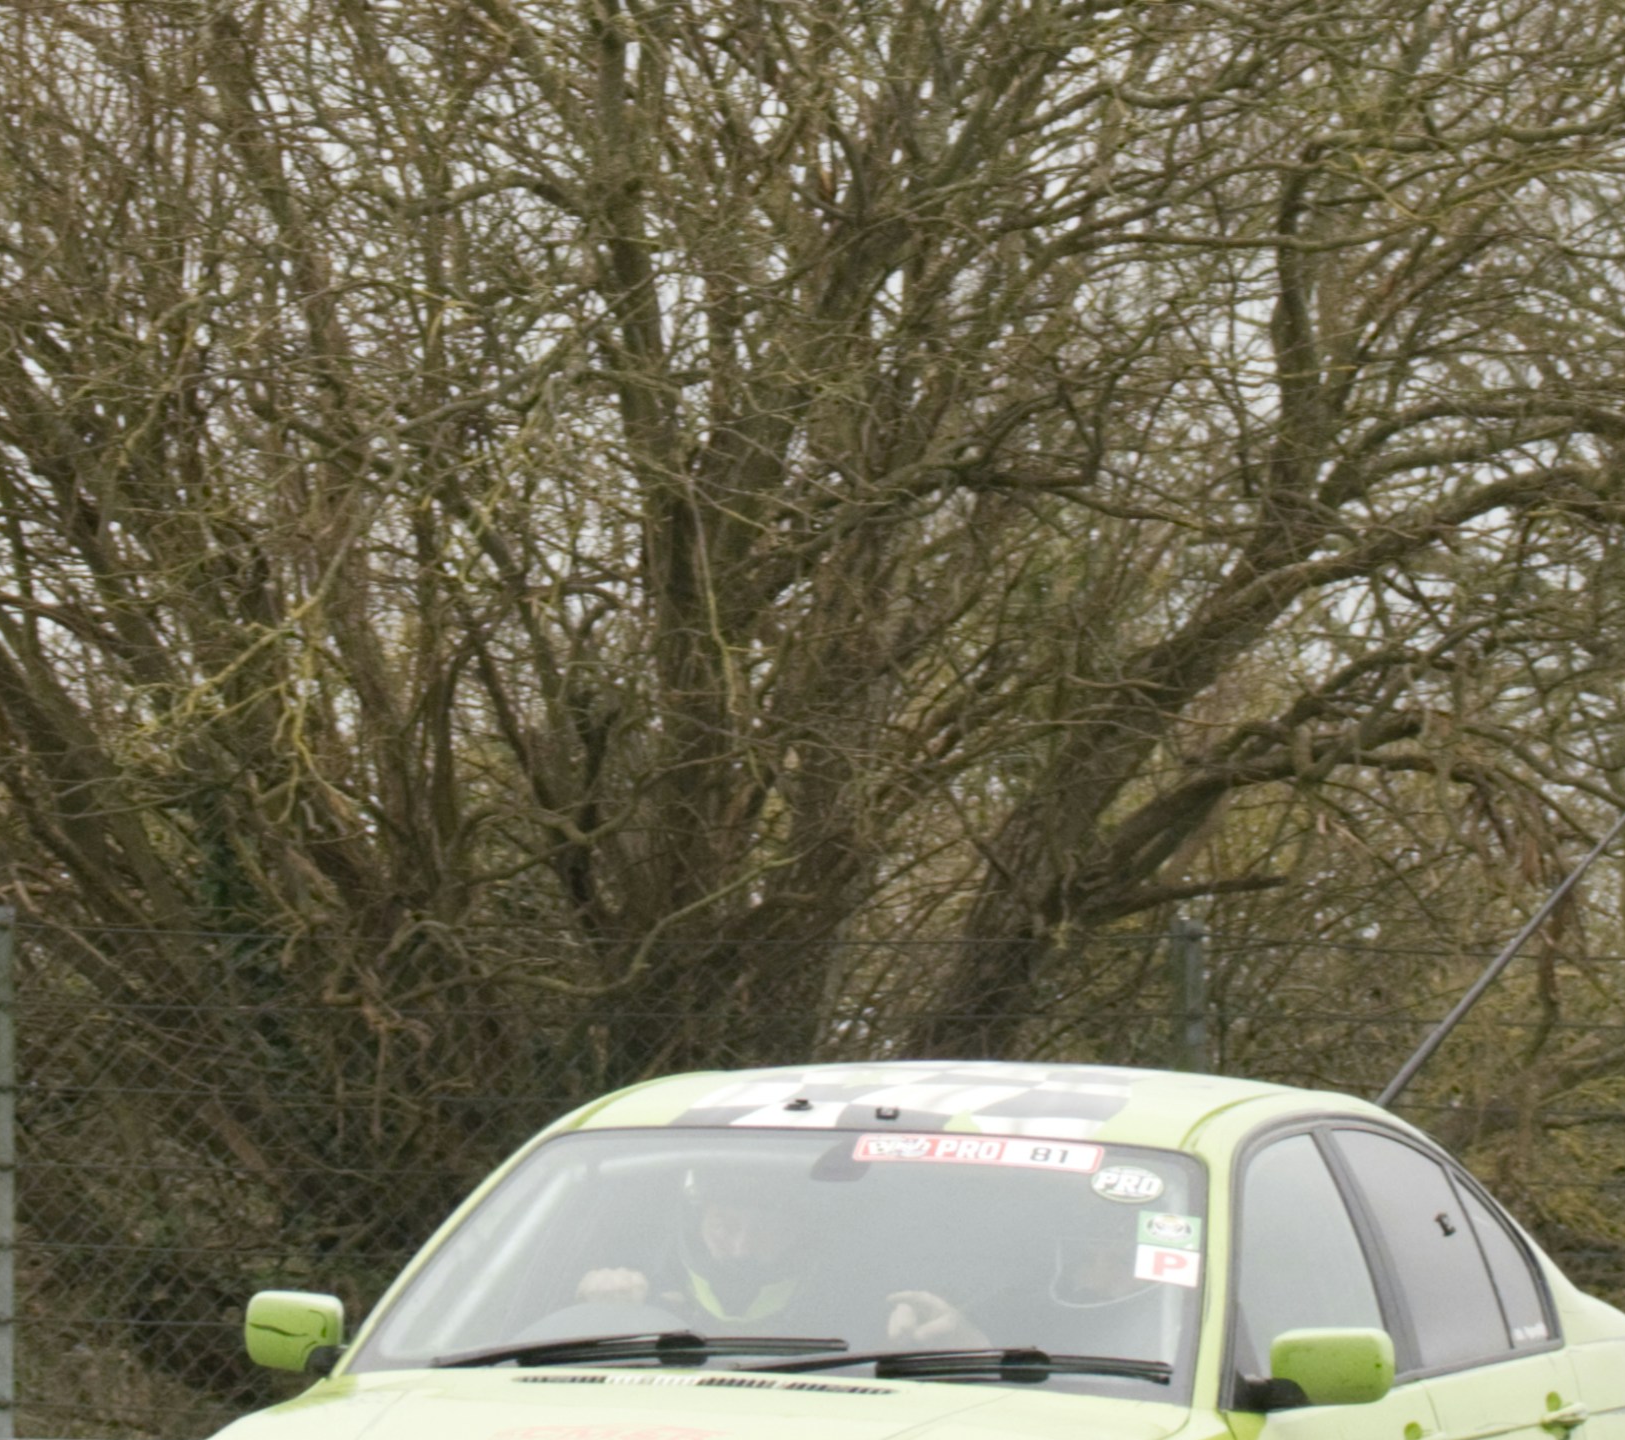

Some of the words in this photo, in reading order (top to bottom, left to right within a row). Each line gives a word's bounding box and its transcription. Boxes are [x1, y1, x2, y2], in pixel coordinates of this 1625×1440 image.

[934, 1138, 1001, 1160] PRO
[1029, 1146, 1070, 1164] 81
[1093, 1168, 1163, 1196] PRO
[1151, 1250, 1189, 1277] P
